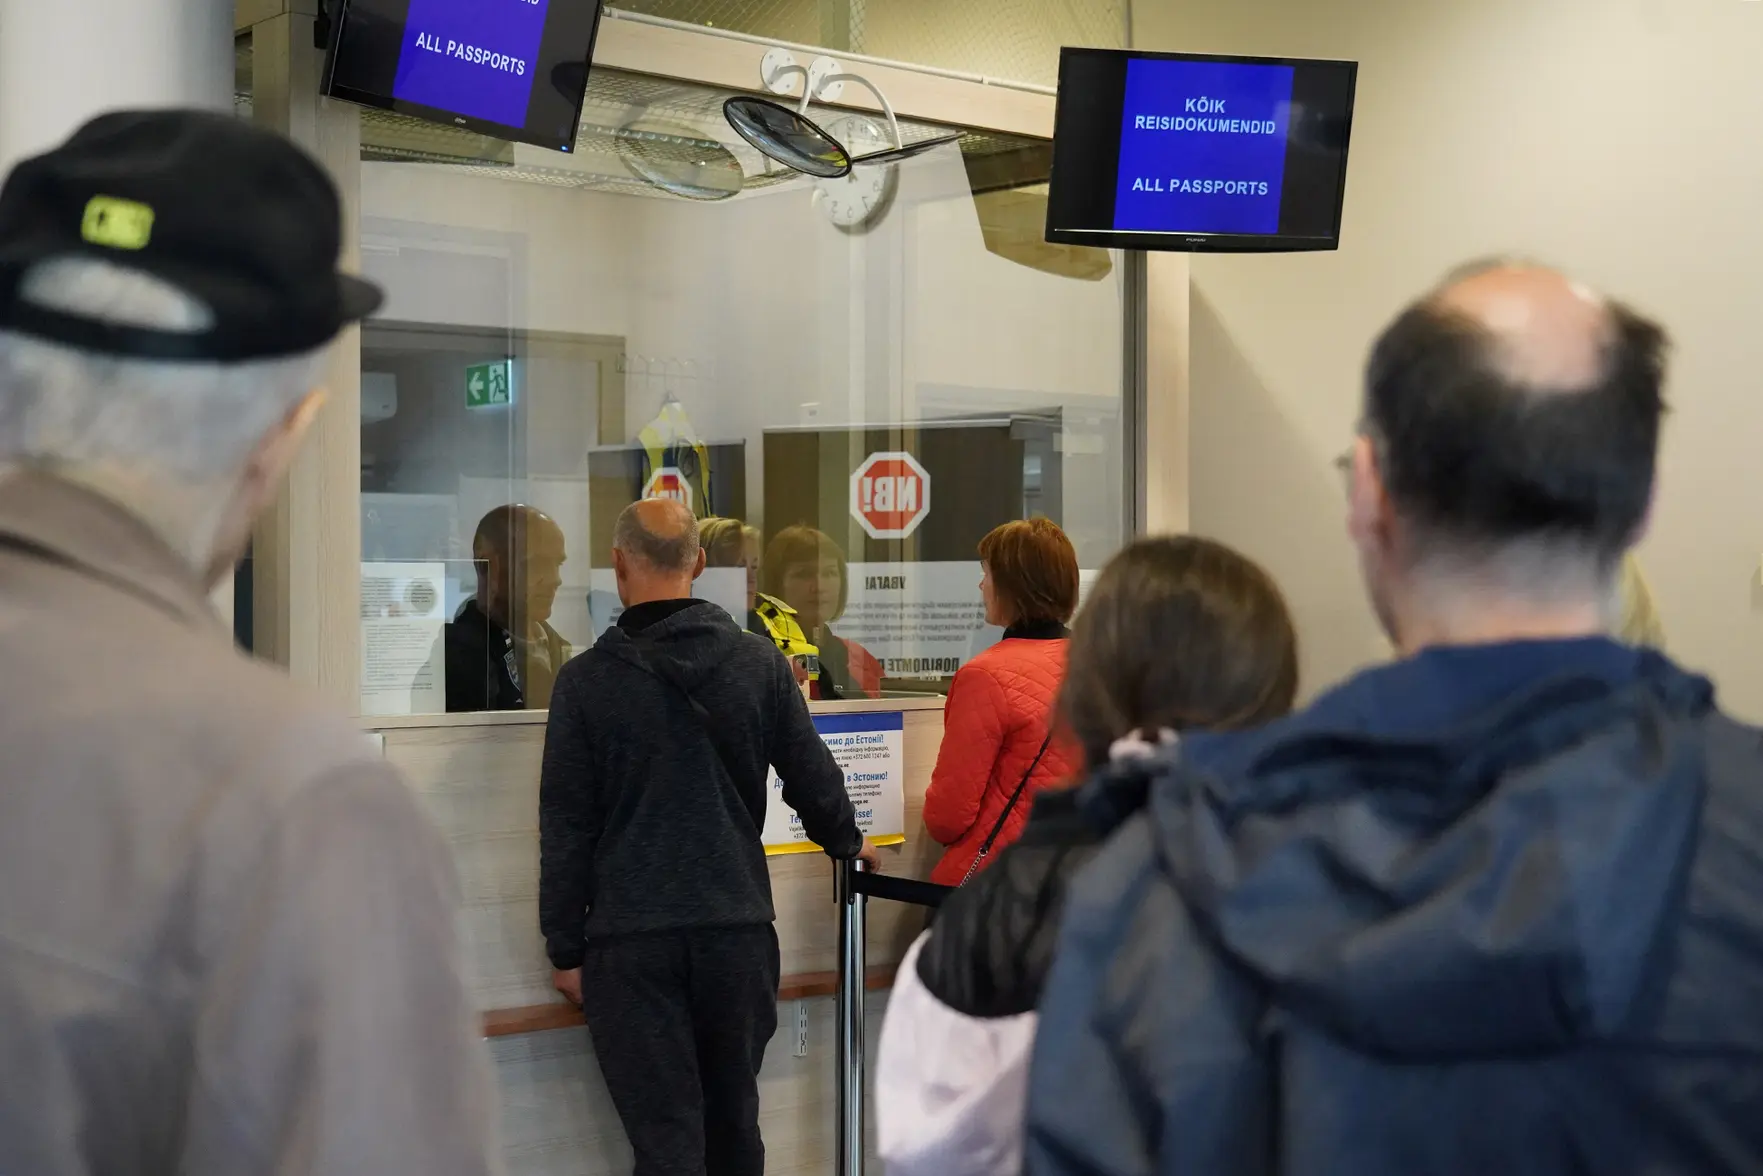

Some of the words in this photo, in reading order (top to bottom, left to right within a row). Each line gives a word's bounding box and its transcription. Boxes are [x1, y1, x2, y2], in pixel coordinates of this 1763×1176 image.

[416, 32, 442, 53] ALL
[447, 40, 525, 76] PASSPORTS
[1185, 96, 1226, 114] KÕIK
[1135, 115, 1276, 134] REISIDOKUMENDID
[1132, 177, 1164, 192] ALL
[1169, 178, 1268, 196] PASSPORTS
[824, 737, 843, 746] симо
[844, 736, 854, 747] до
[856, 734, 884, 745] Естонії!
[853, 772, 888, 782] Эстонию!
[855, 809, 872, 818] isse!
